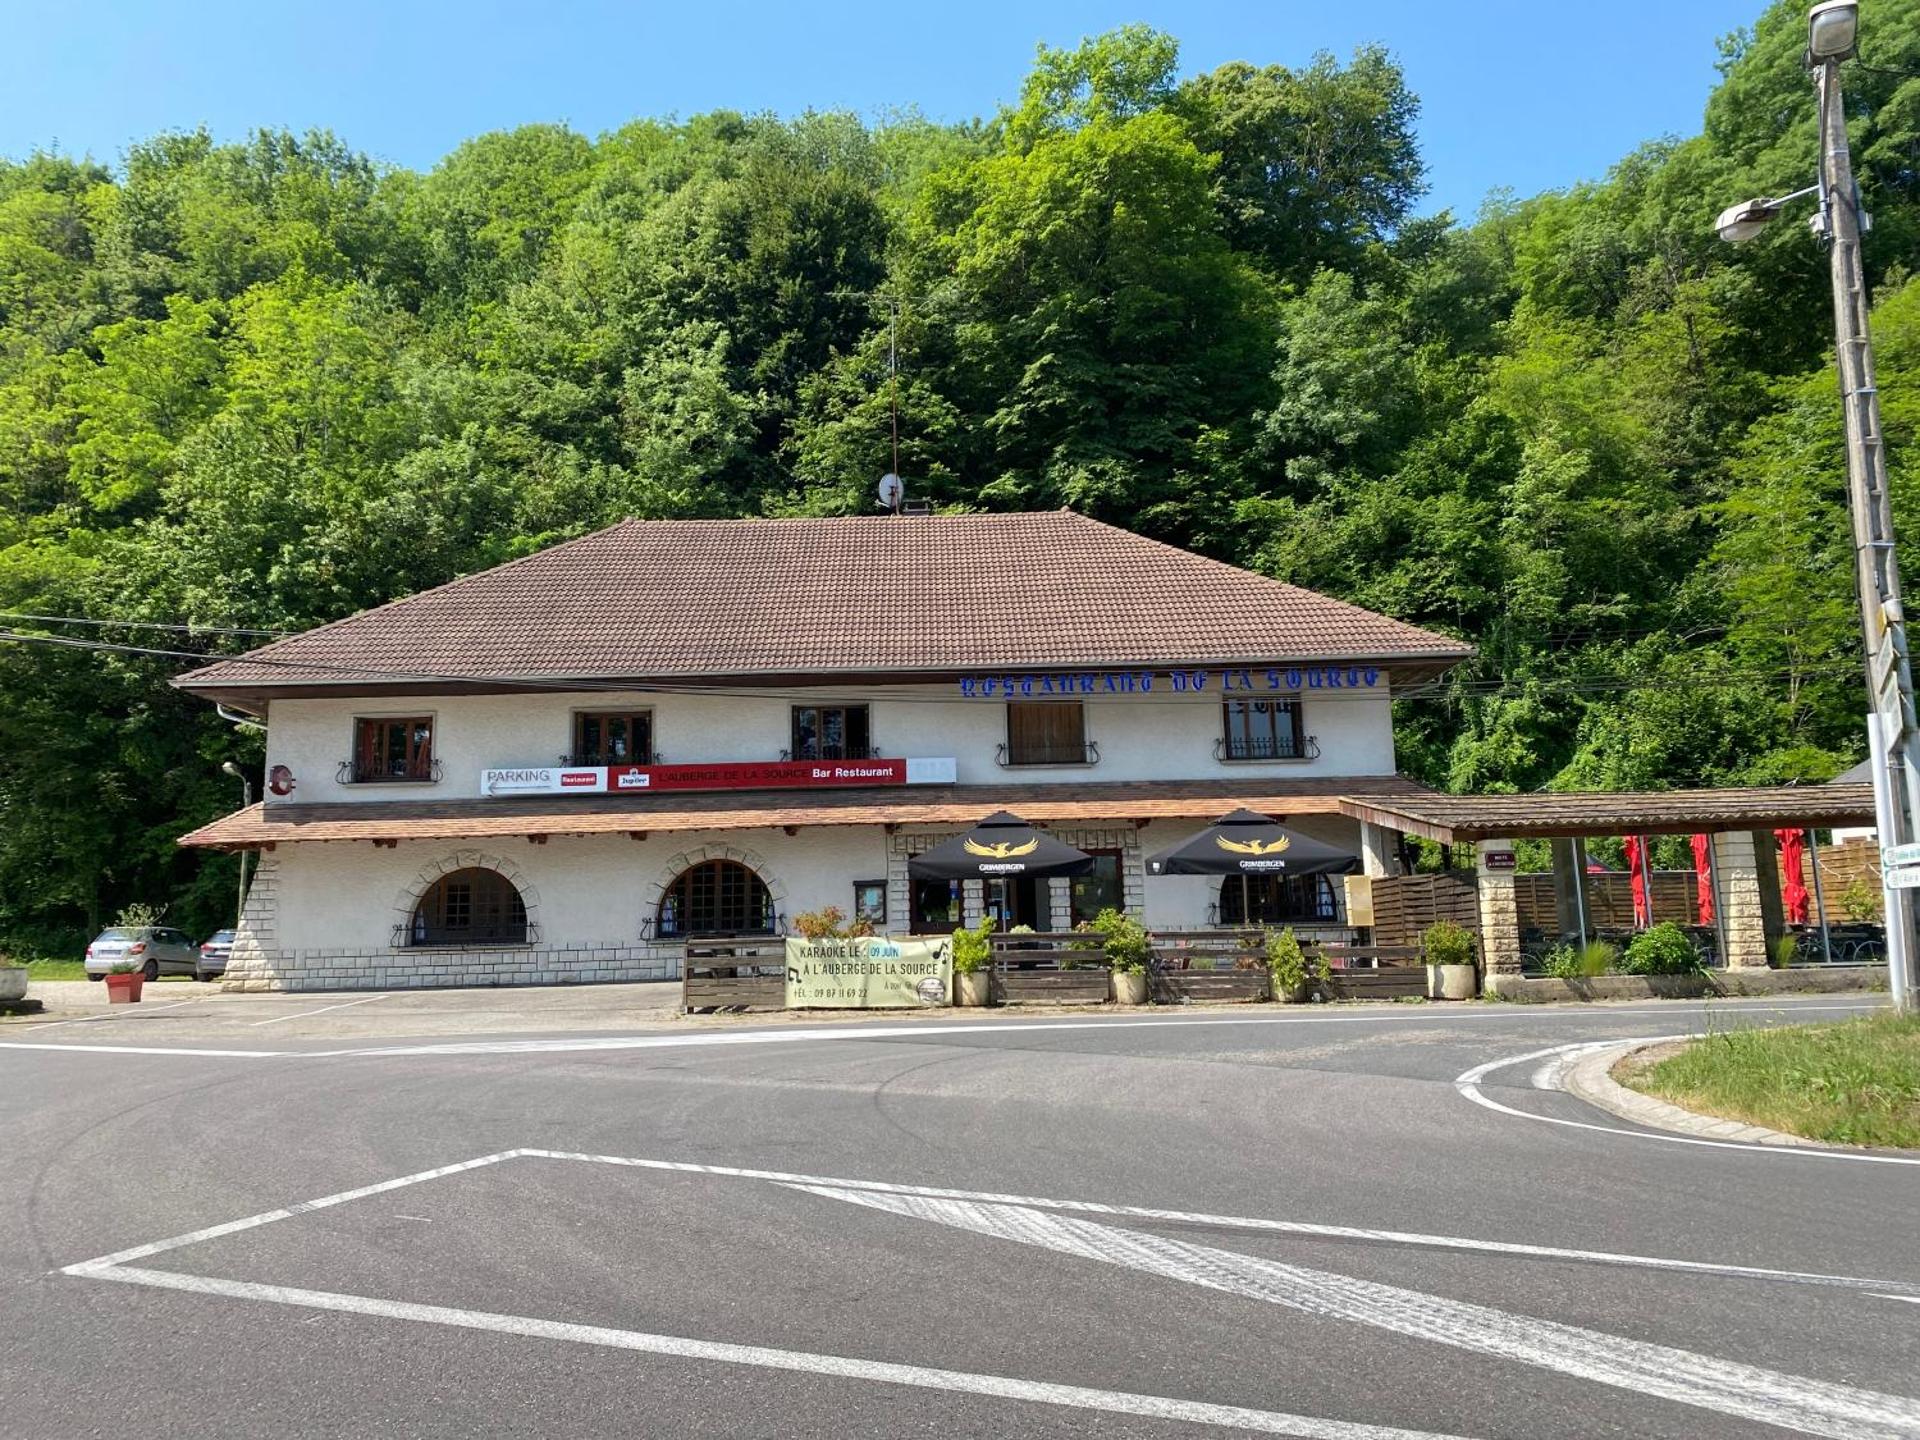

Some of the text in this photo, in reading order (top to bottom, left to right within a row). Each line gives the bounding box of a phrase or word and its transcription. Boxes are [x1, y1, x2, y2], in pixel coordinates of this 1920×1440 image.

[1171, 669, 1208, 693] DE
[1223, 669, 1253, 691] LA
[1266, 665, 1380, 690] SOURCE
[487, 770, 550, 782] PARKING
[658, 768, 808, 782] L'AUBERGE DE LA SOURCE
[812, 767, 894, 778] Bar Restaurant
[978, 863, 1025, 871] GRIMBERGEN
[1239, 860, 1285, 868] GRIMBERGEN
[800, 946, 846, 958] KARAOKE
[849, 945, 861, 957] LE
[870, 946, 900, 957] 09 JUIN
[813, 963, 866, 975] L'AUBERGE
[869, 963, 882, 975] DE
[885, 963, 897, 975] LA
[900, 963, 938, 975] SOURCE
